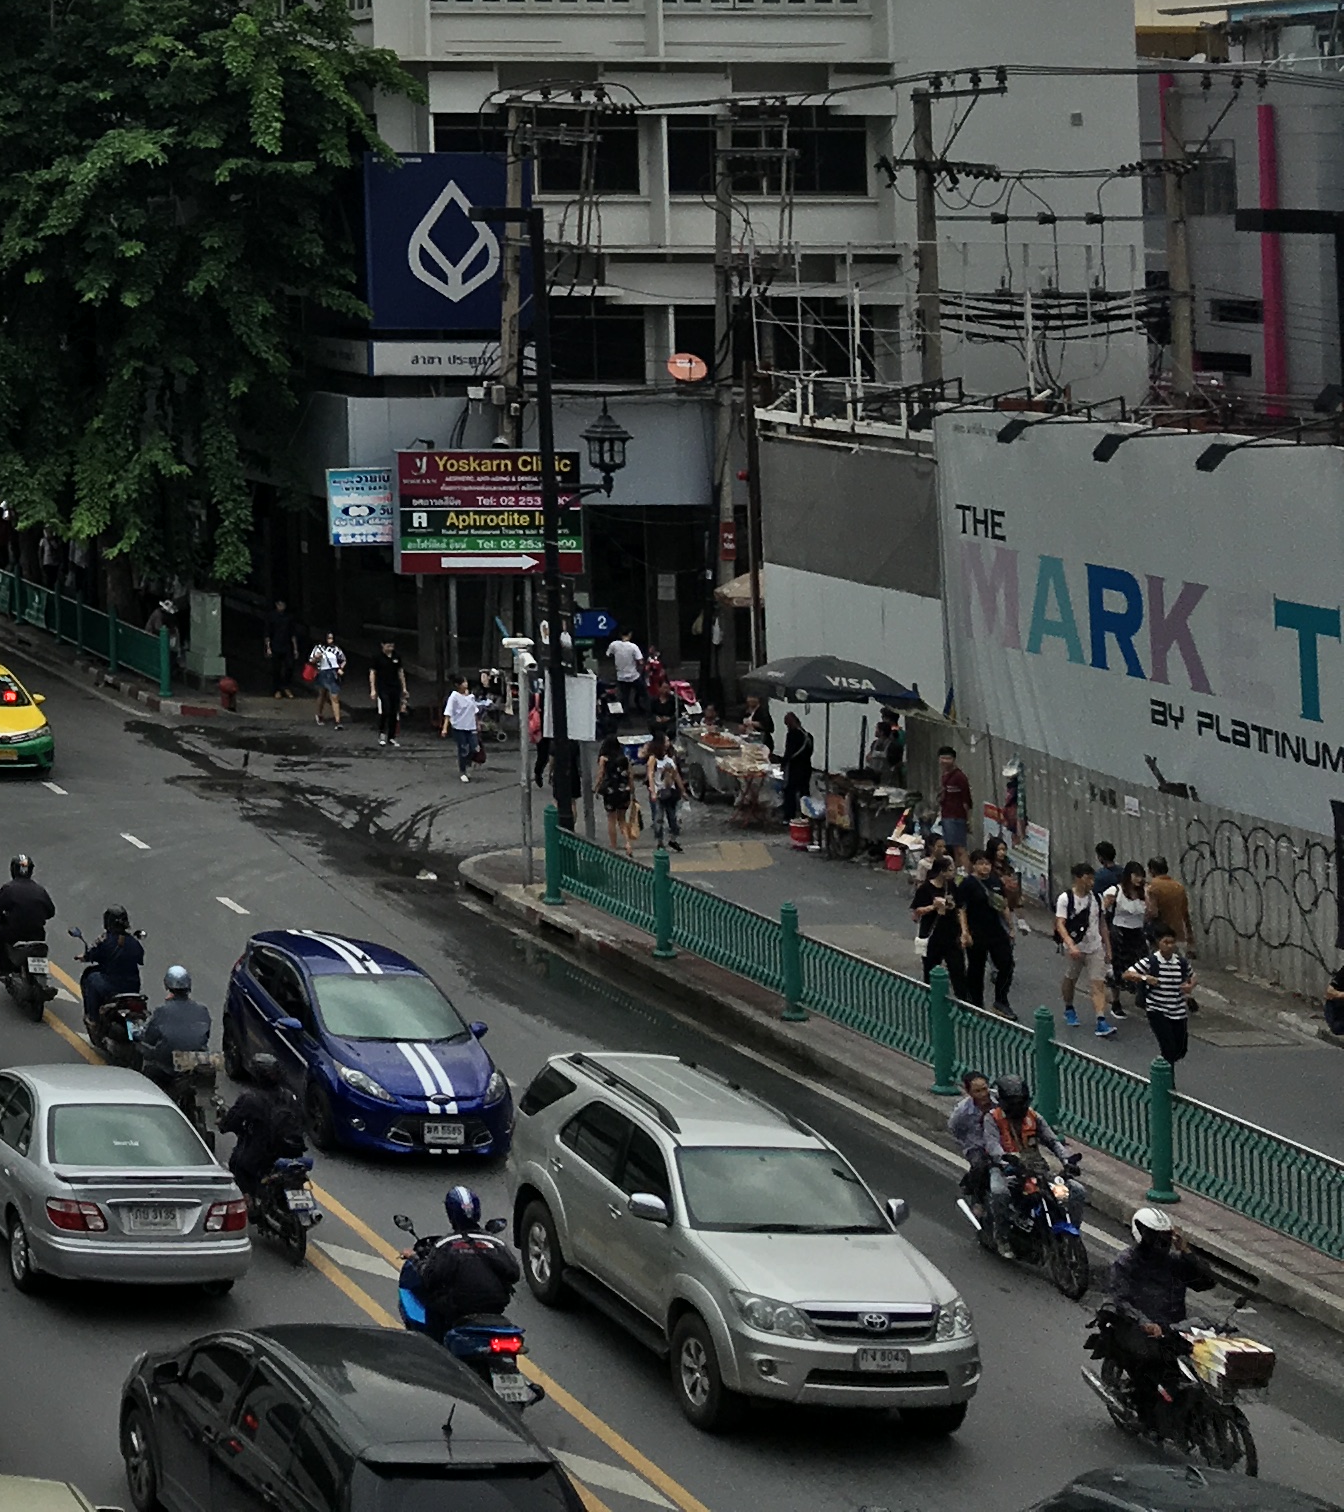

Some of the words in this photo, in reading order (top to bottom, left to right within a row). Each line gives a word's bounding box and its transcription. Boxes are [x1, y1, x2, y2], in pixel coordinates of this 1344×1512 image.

[434, 455, 512, 472] Yoskarn
[517, 455, 571, 472] Cliic
[499, 496, 515, 506] 02
[446, 512, 530, 529] Aphrodite
[954, 503, 1007, 542] THE
[500, 539, 516, 549] 02
[597, 615, 608, 630] 2
[958, 541, 1343, 724] MARKT
[825, 675, 876, 691] VISA
[1149, 697, 1185, 732] BY
